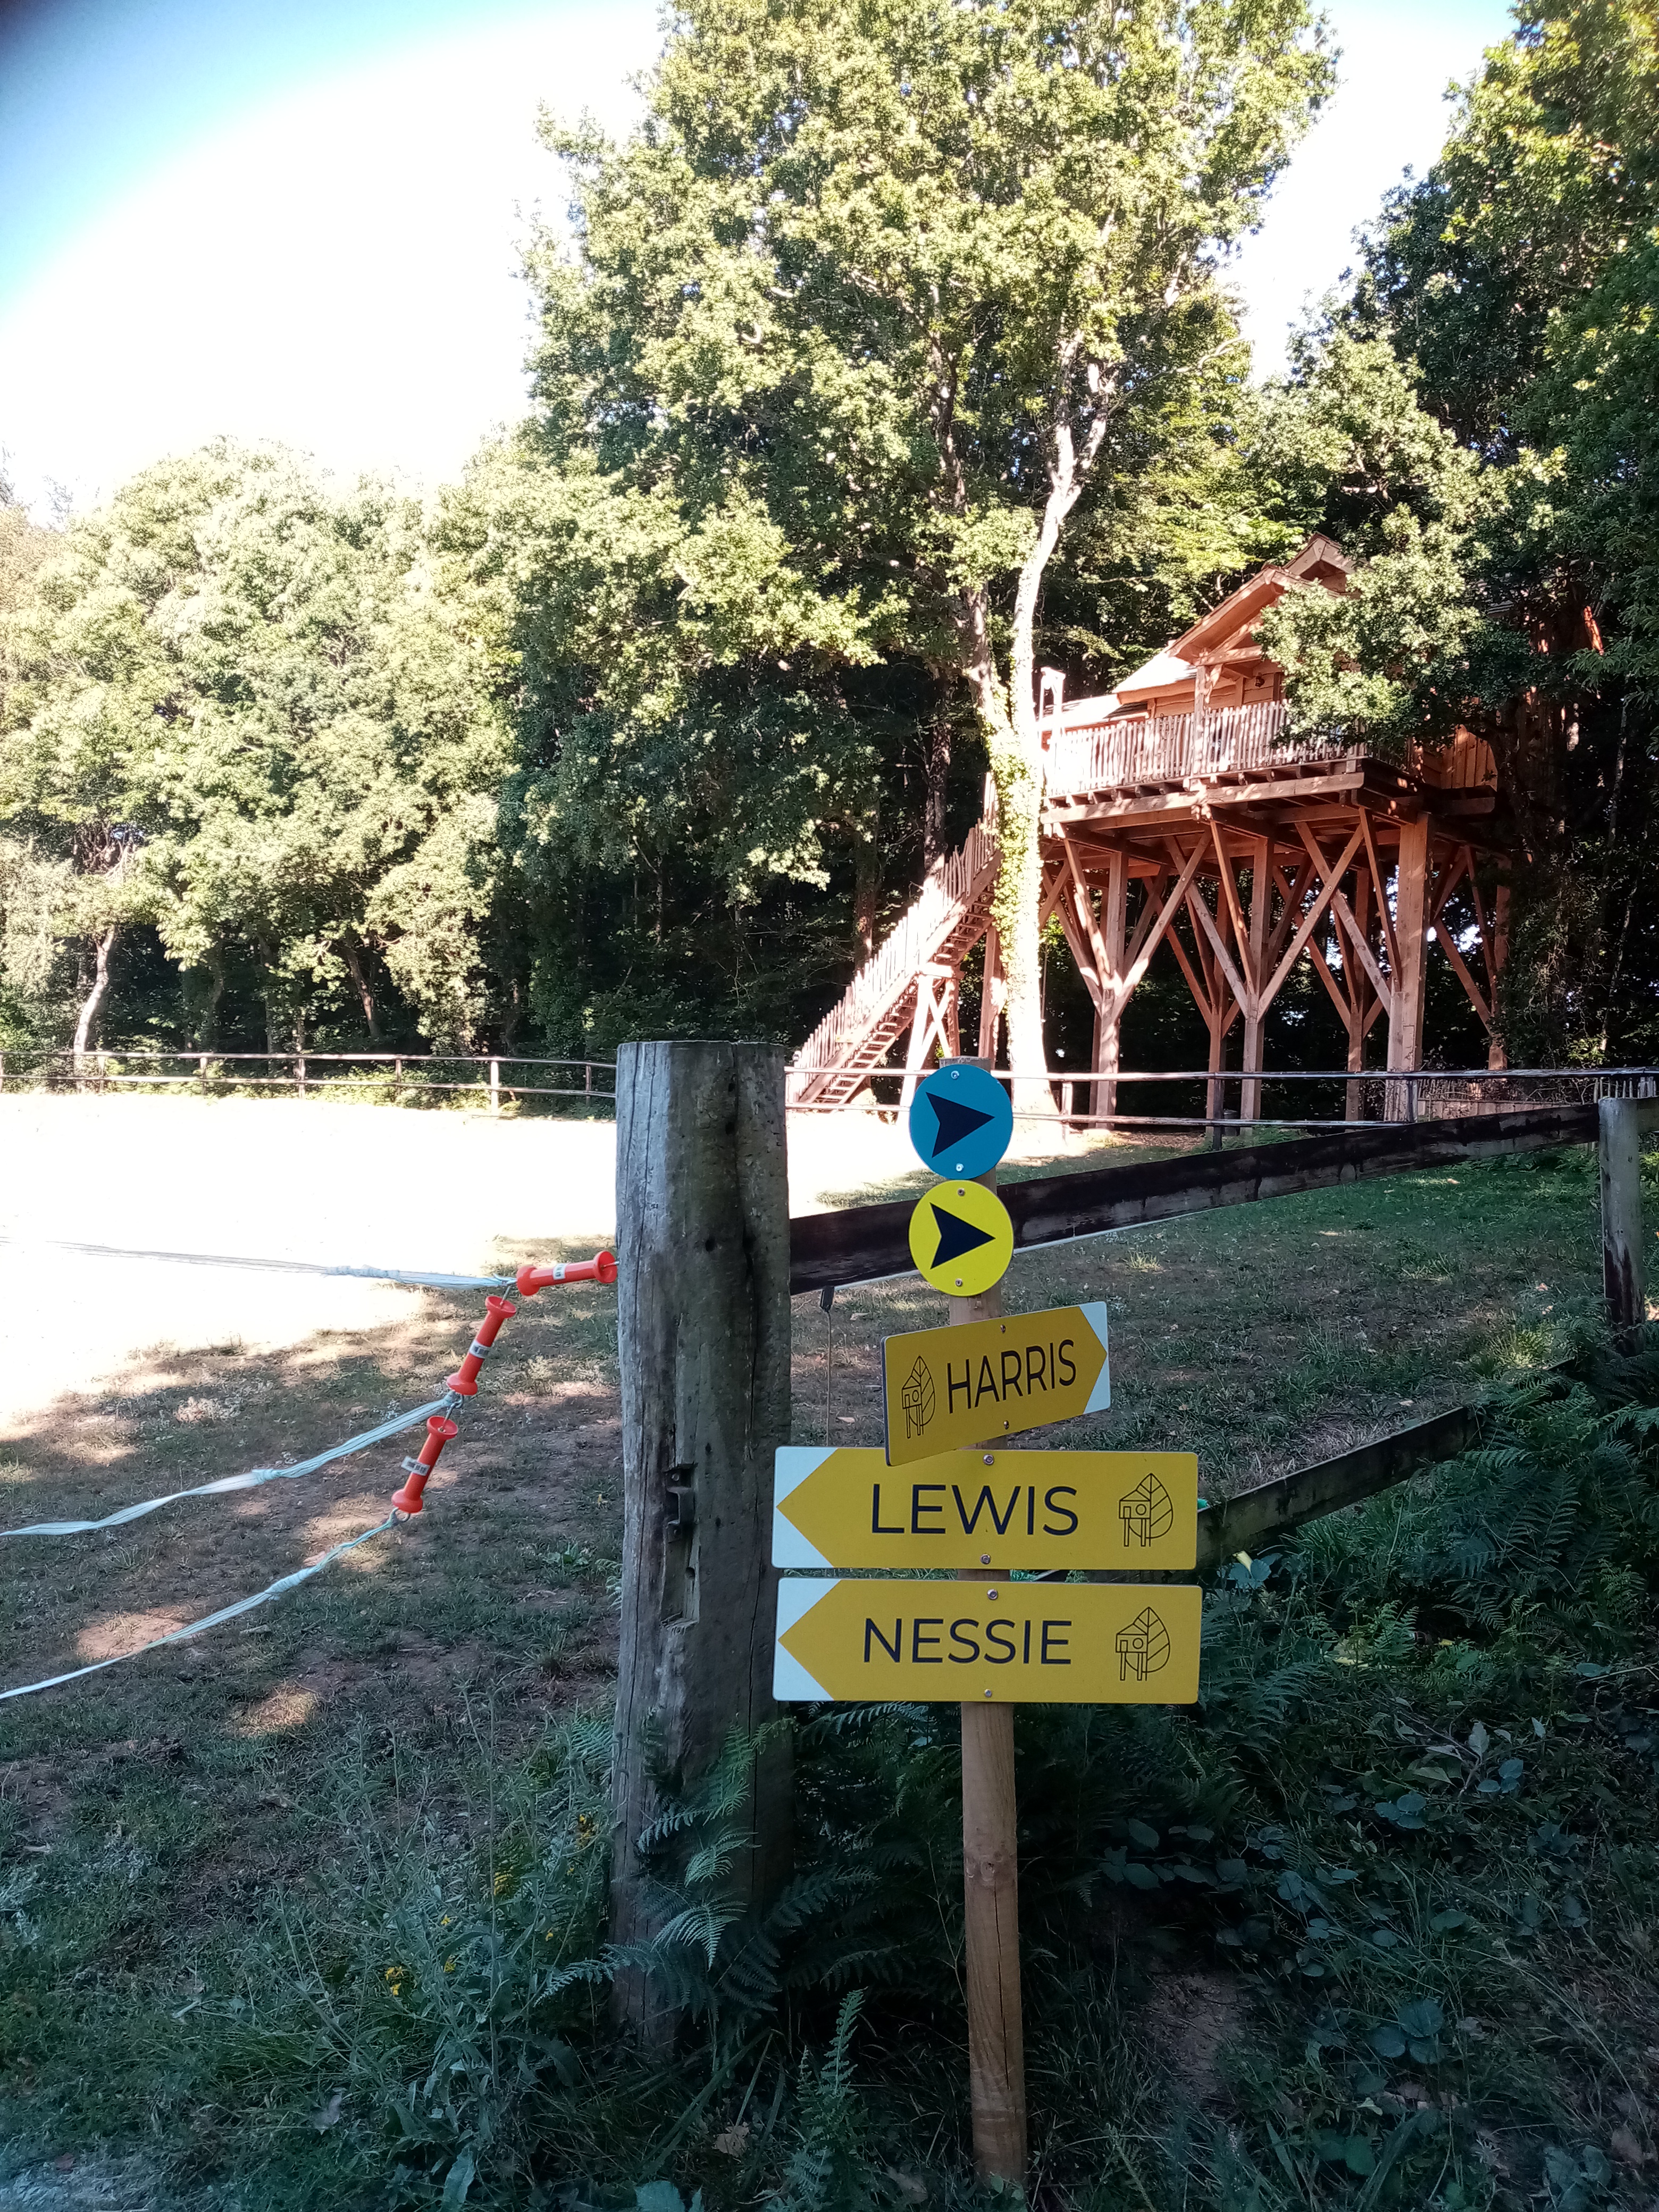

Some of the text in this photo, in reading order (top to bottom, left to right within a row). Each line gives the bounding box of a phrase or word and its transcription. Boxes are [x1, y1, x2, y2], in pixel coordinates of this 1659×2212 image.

[946, 1339, 1077, 1414] HARRIS
[872, 1484, 1078, 1536] LEWIS
[864, 1618, 1072, 1665] NESSIE
